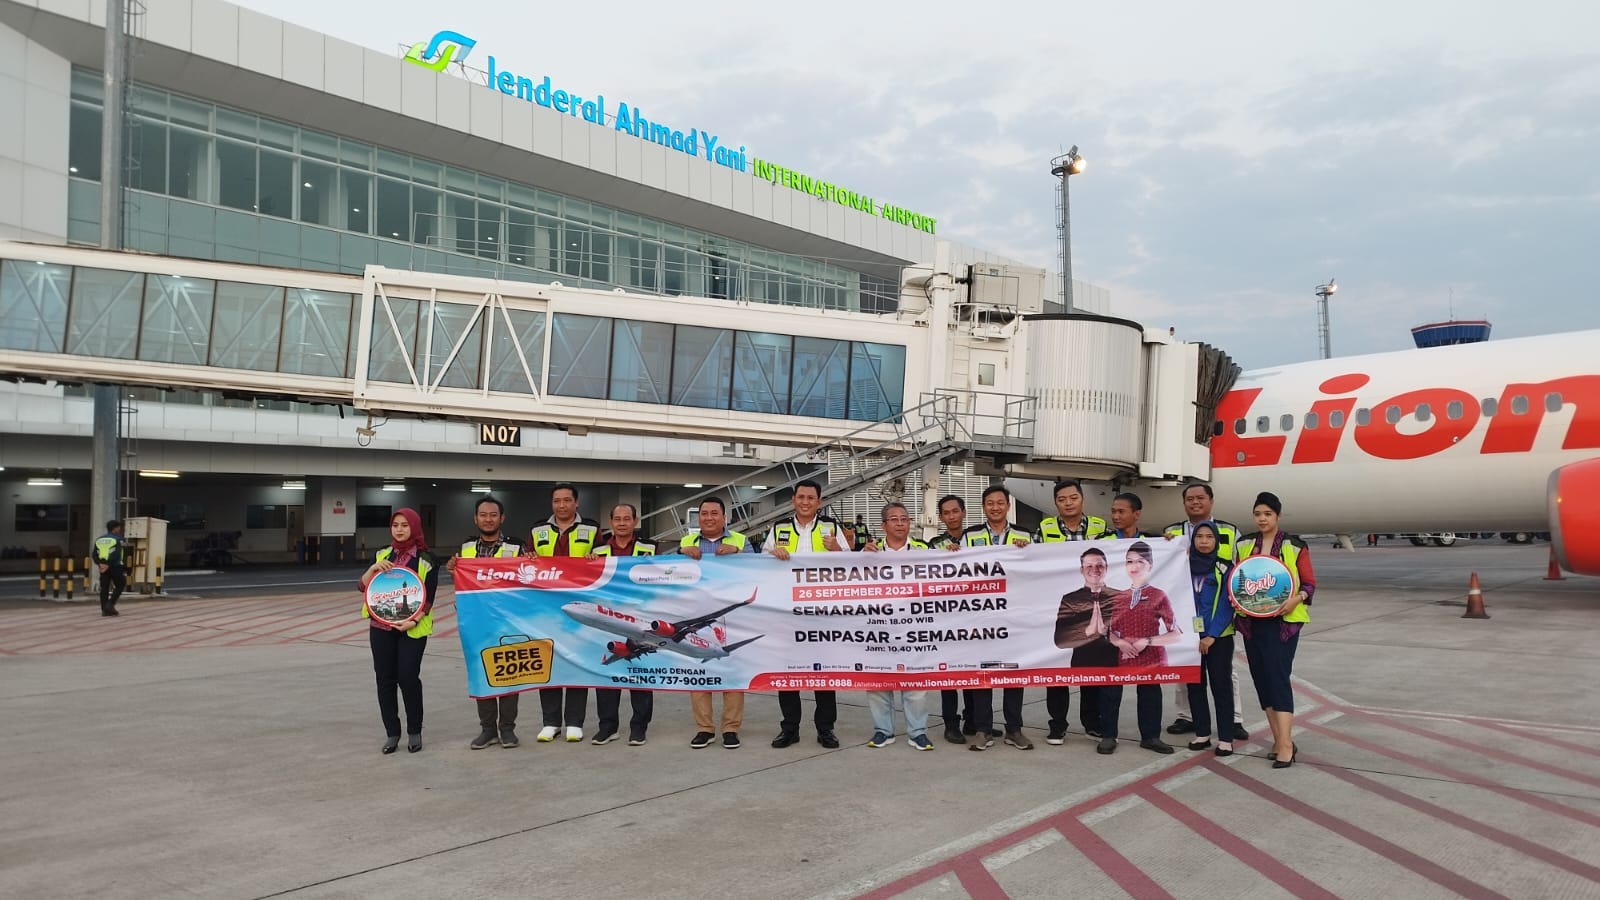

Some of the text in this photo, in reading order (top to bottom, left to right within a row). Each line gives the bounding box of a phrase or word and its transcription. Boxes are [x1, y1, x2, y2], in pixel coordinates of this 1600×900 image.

[615, 102, 697, 156] Ahmad
[701, 130, 745, 172] Yani
[753, 157, 878, 217] INTERNATIONAL
[882, 203, 937, 235] AIRPORT
[476, 566, 563, 581] Lion air
[792, 561, 1006, 583] TERBANG PERDANA
[799, 582, 1000, 599] 26 SEPTEMBER 2023 SETIAP HARI
[597, 604, 636, 623] Lion
[792, 603, 894, 616] SEMARANG
[910, 598, 1007, 615] DENPASAR
[889, 617, 913, 625] 18.00
[915, 616, 934, 624] WIB
[794, 630, 890, 643] DENPASAR
[906, 627, 1009, 643] SEMARANG
[493, 647, 541, 664] FREE
[914, 644, 938, 652] WITA
[494, 659, 543, 677] 20KG
[611, 676, 722, 685] BOEING 737-900ER
[770, 679, 787, 687] +62
[789, 679, 803, 687] 811
[805, 679, 826, 687] 1938
[828, 678, 852, 687] 0888
[899, 677, 980, 687] www.lionair.co.id
[990, 672, 1181, 685] Hubungi Biro Perjalanan Terdekat Anda
